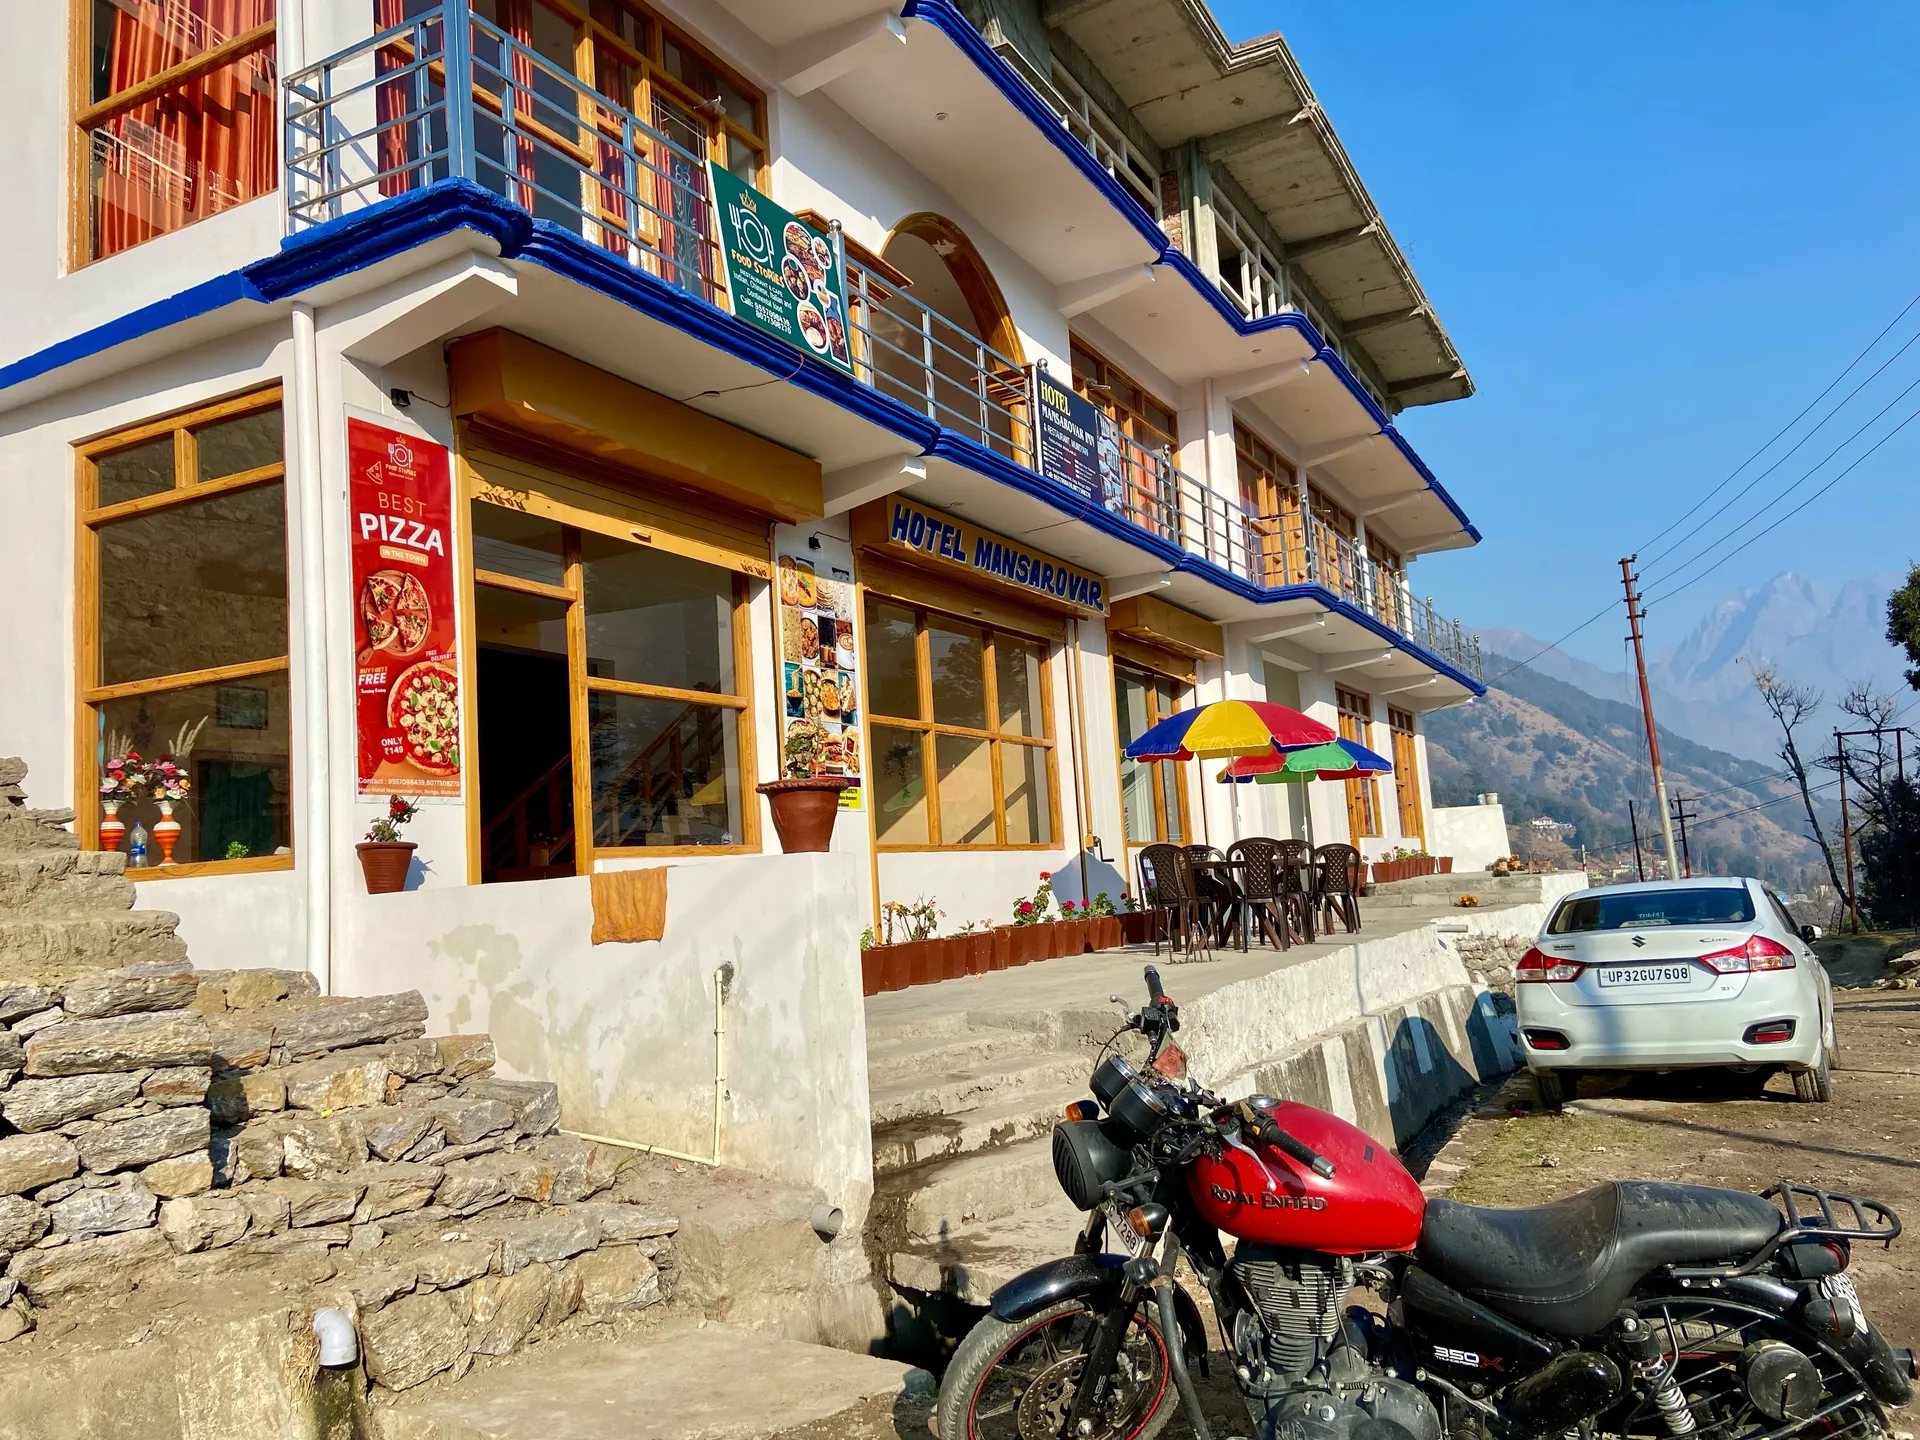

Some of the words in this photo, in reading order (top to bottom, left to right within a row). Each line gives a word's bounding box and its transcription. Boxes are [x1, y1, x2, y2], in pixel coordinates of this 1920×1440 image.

[731, 248, 752, 269] FOOD
[1040, 379, 1071, 417] HOTEL
[1041, 403, 1085, 441] MANSAROVAR
[378, 491, 427, 517] BEST
[359, 512, 444, 557] PIZZA
[382, 548, 390, 556] IN
[404, 552, 426, 564] TOWN
[891, 503, 968, 564] HOTEL
[974, 536, 1106, 612] MANSAROVAR
[358, 672, 387, 686] FREE
[381, 736, 403, 747] ONLY
[358, 777, 384, 785] Contact
[1608, 967, 1688, 983] UP32GU7608
[1210, 1183, 1259, 1206] ROYAL
[1261, 1191, 1328, 1211] ENFIELD
[1092, 1375, 1107, 1403] ABS
